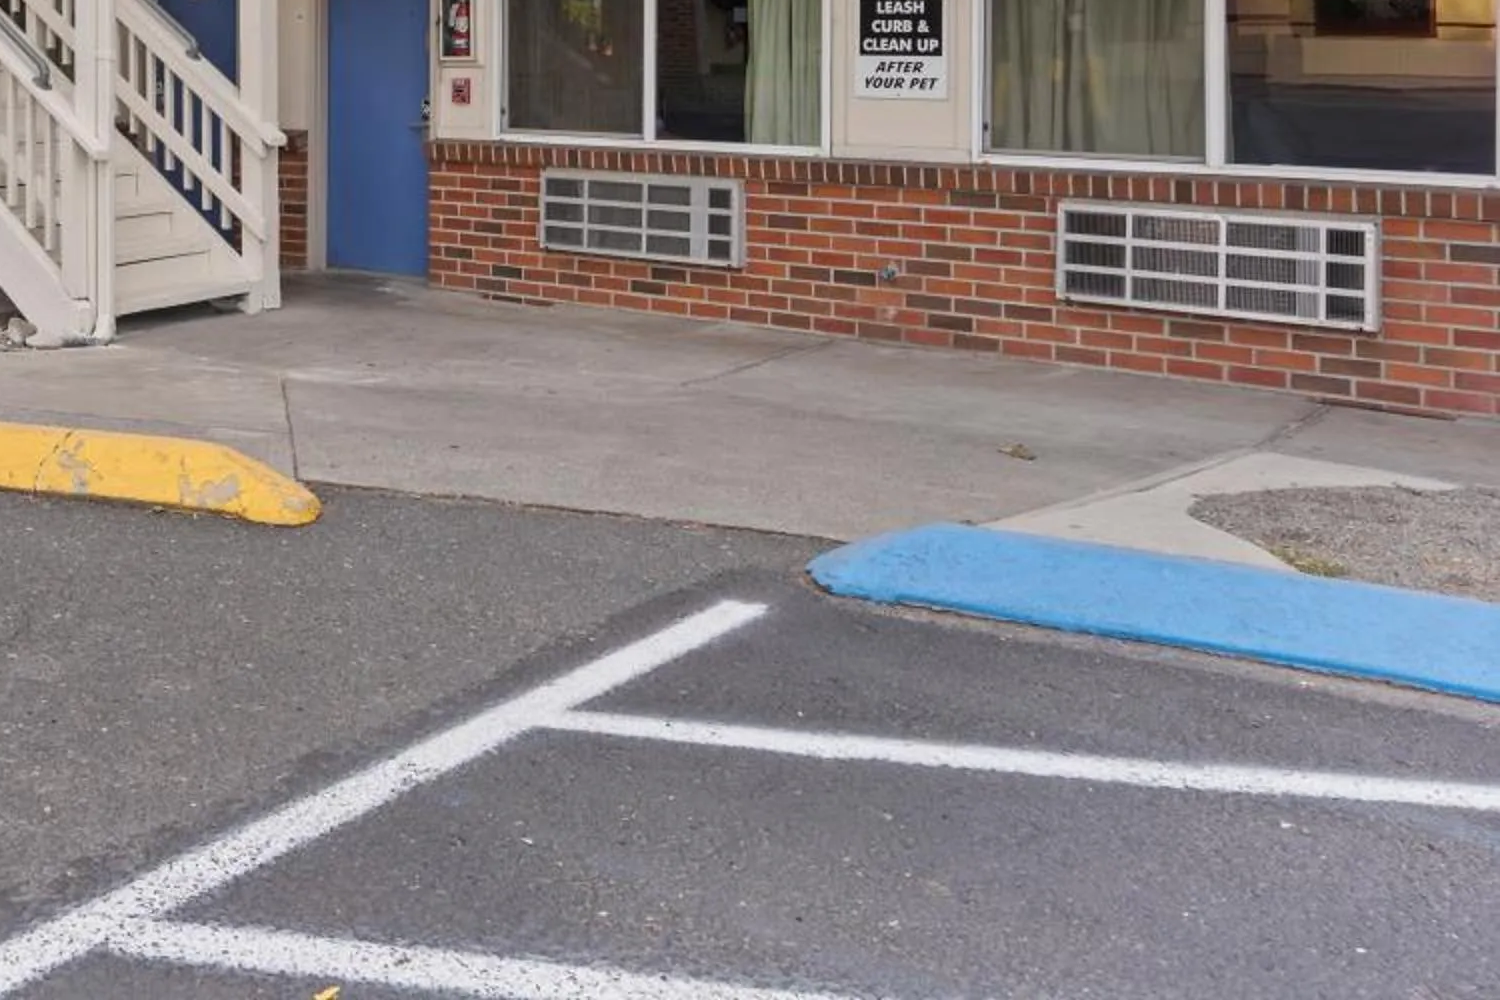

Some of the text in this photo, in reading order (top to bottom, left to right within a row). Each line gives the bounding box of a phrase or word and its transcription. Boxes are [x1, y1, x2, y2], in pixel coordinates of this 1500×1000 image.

[876, 0, 925, 14] LEASH
[871, 20, 930, 33] CURB &
[862, 37, 939, 52] CLEAN UP
[876, 61, 924, 73] AFTER
[865, 77, 939, 90] YOUR PET
